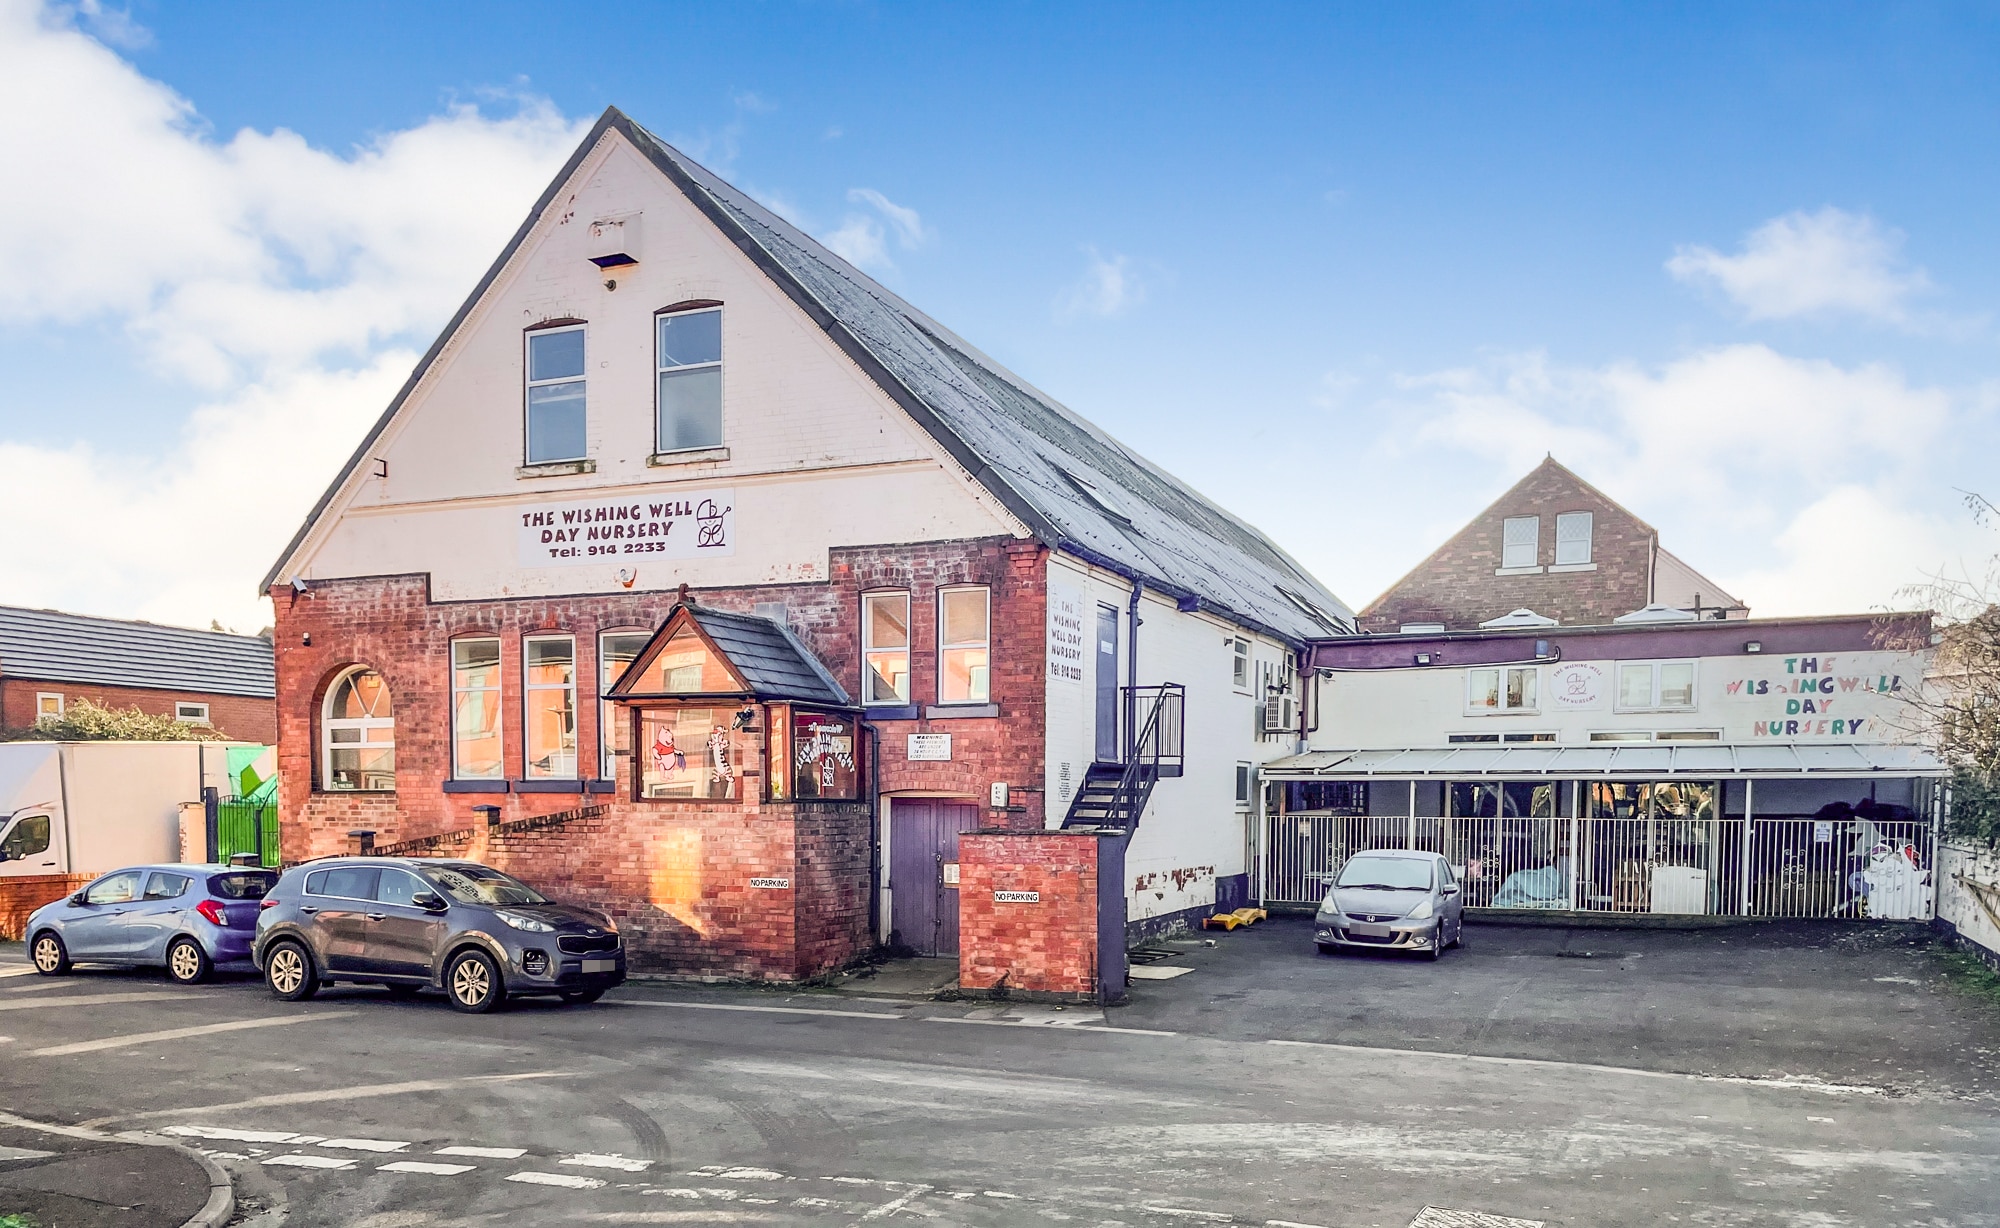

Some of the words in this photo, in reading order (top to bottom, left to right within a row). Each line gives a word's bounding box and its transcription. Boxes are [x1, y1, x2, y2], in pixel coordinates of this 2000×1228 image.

[522, 511, 554, 527] THE
[562, 504, 641, 524] WISHING
[649, 501, 693, 518] WELL
[541, 528, 580, 543] DAY
[587, 521, 674, 540] NURSERY
[549, 547, 581, 558] Tel:
[588, 545, 617, 556] 914
[624, 542, 666, 553] 2233
[1061, 601, 1073, 613] THE
[1053, 614, 1081, 632] WISHING
[1051, 628, 1066, 643] WELL
[1067, 633, 1082, 646] DAY
[1051, 644, 1081, 660] NURSERY
[1553, 667, 1563, 678] THE
[1784, 657, 1836, 674] THE
[1786, 698, 1833, 715] DAY
[761, 879, 788, 887] PARKING
[995, 892, 1006, 900] NO
[1006, 893, 1038, 901] PARKING
